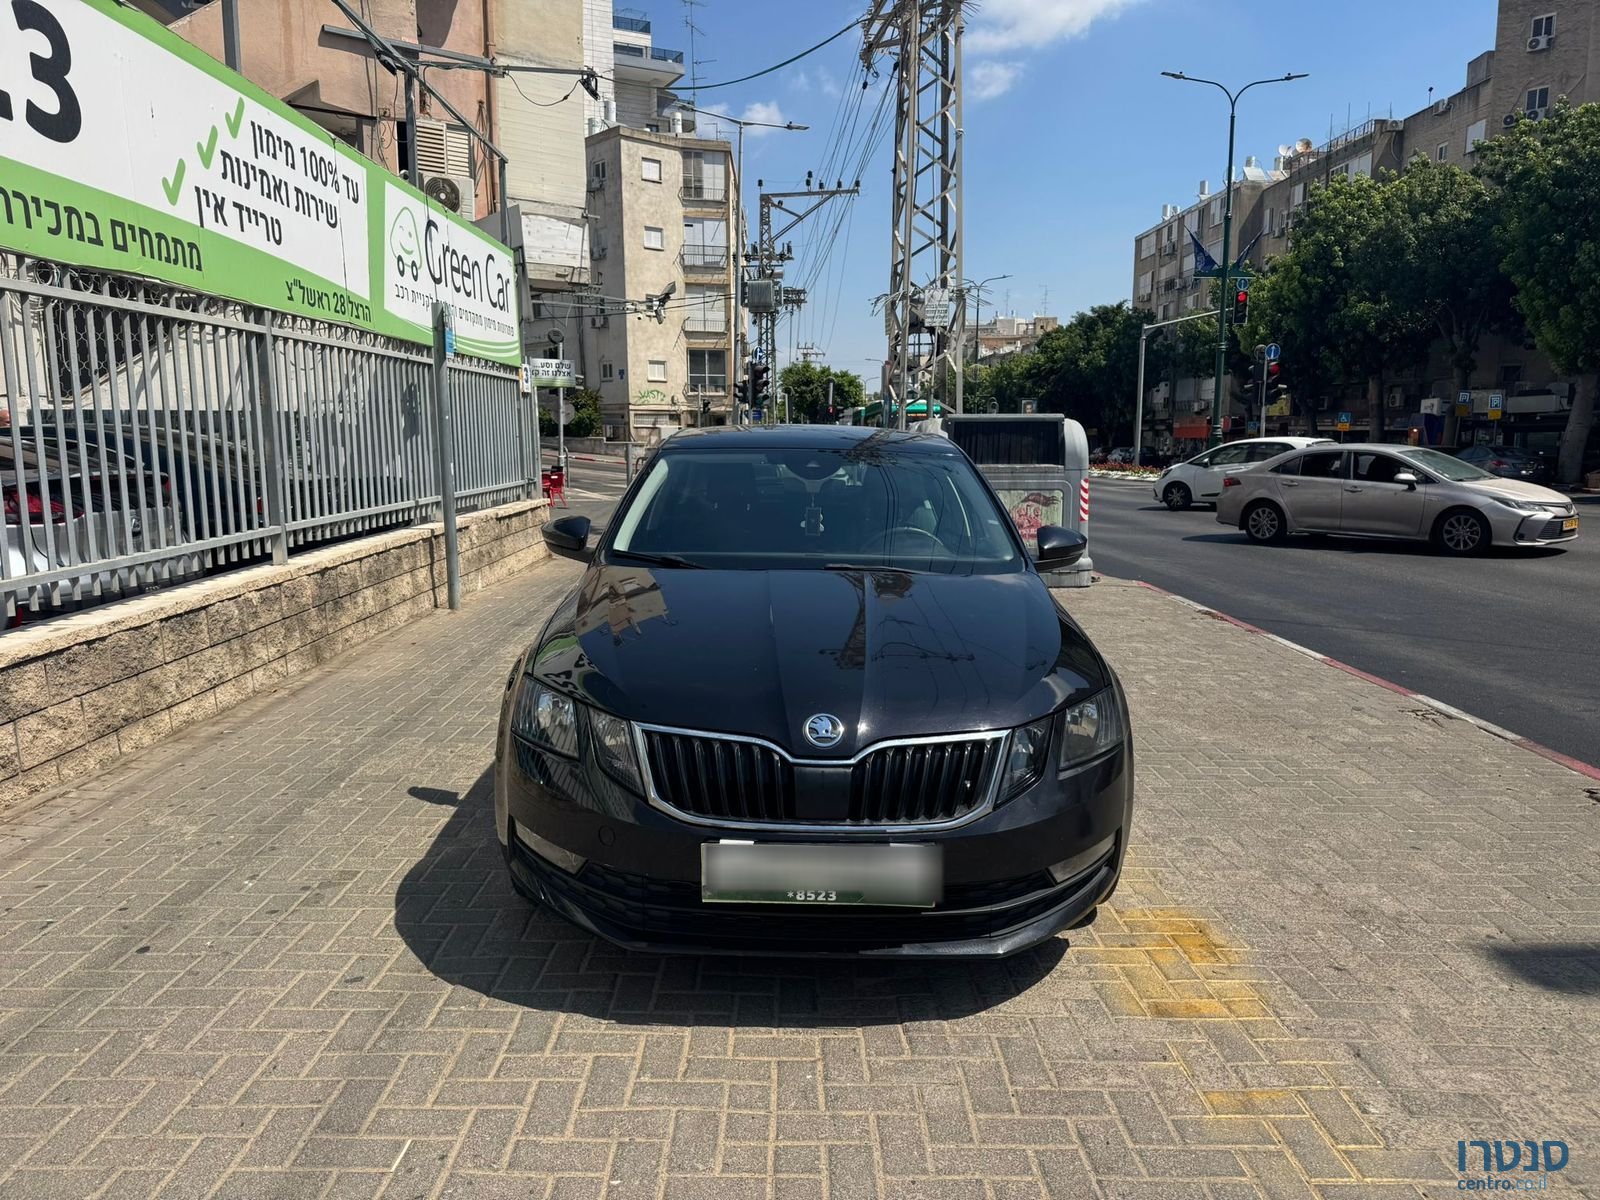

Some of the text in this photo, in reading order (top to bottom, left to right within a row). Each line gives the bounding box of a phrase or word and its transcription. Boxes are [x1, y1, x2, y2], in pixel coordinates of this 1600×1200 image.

[250, 120, 359, 205] עד 100% מימון
[220, 149, 338, 229] שירות ואמינות
[194, 185, 283, 246] טרייד אין
[110, 218, 203, 272] מתמחים
[424, 218, 511, 313] Green Car
[332, 291, 346, 315] 28
[347, 295, 372, 323] הרצל
[394, 283, 410, 299] רכב
[552, 369, 571, 377] אצלנו
[555, 362, 571, 370] שלם
